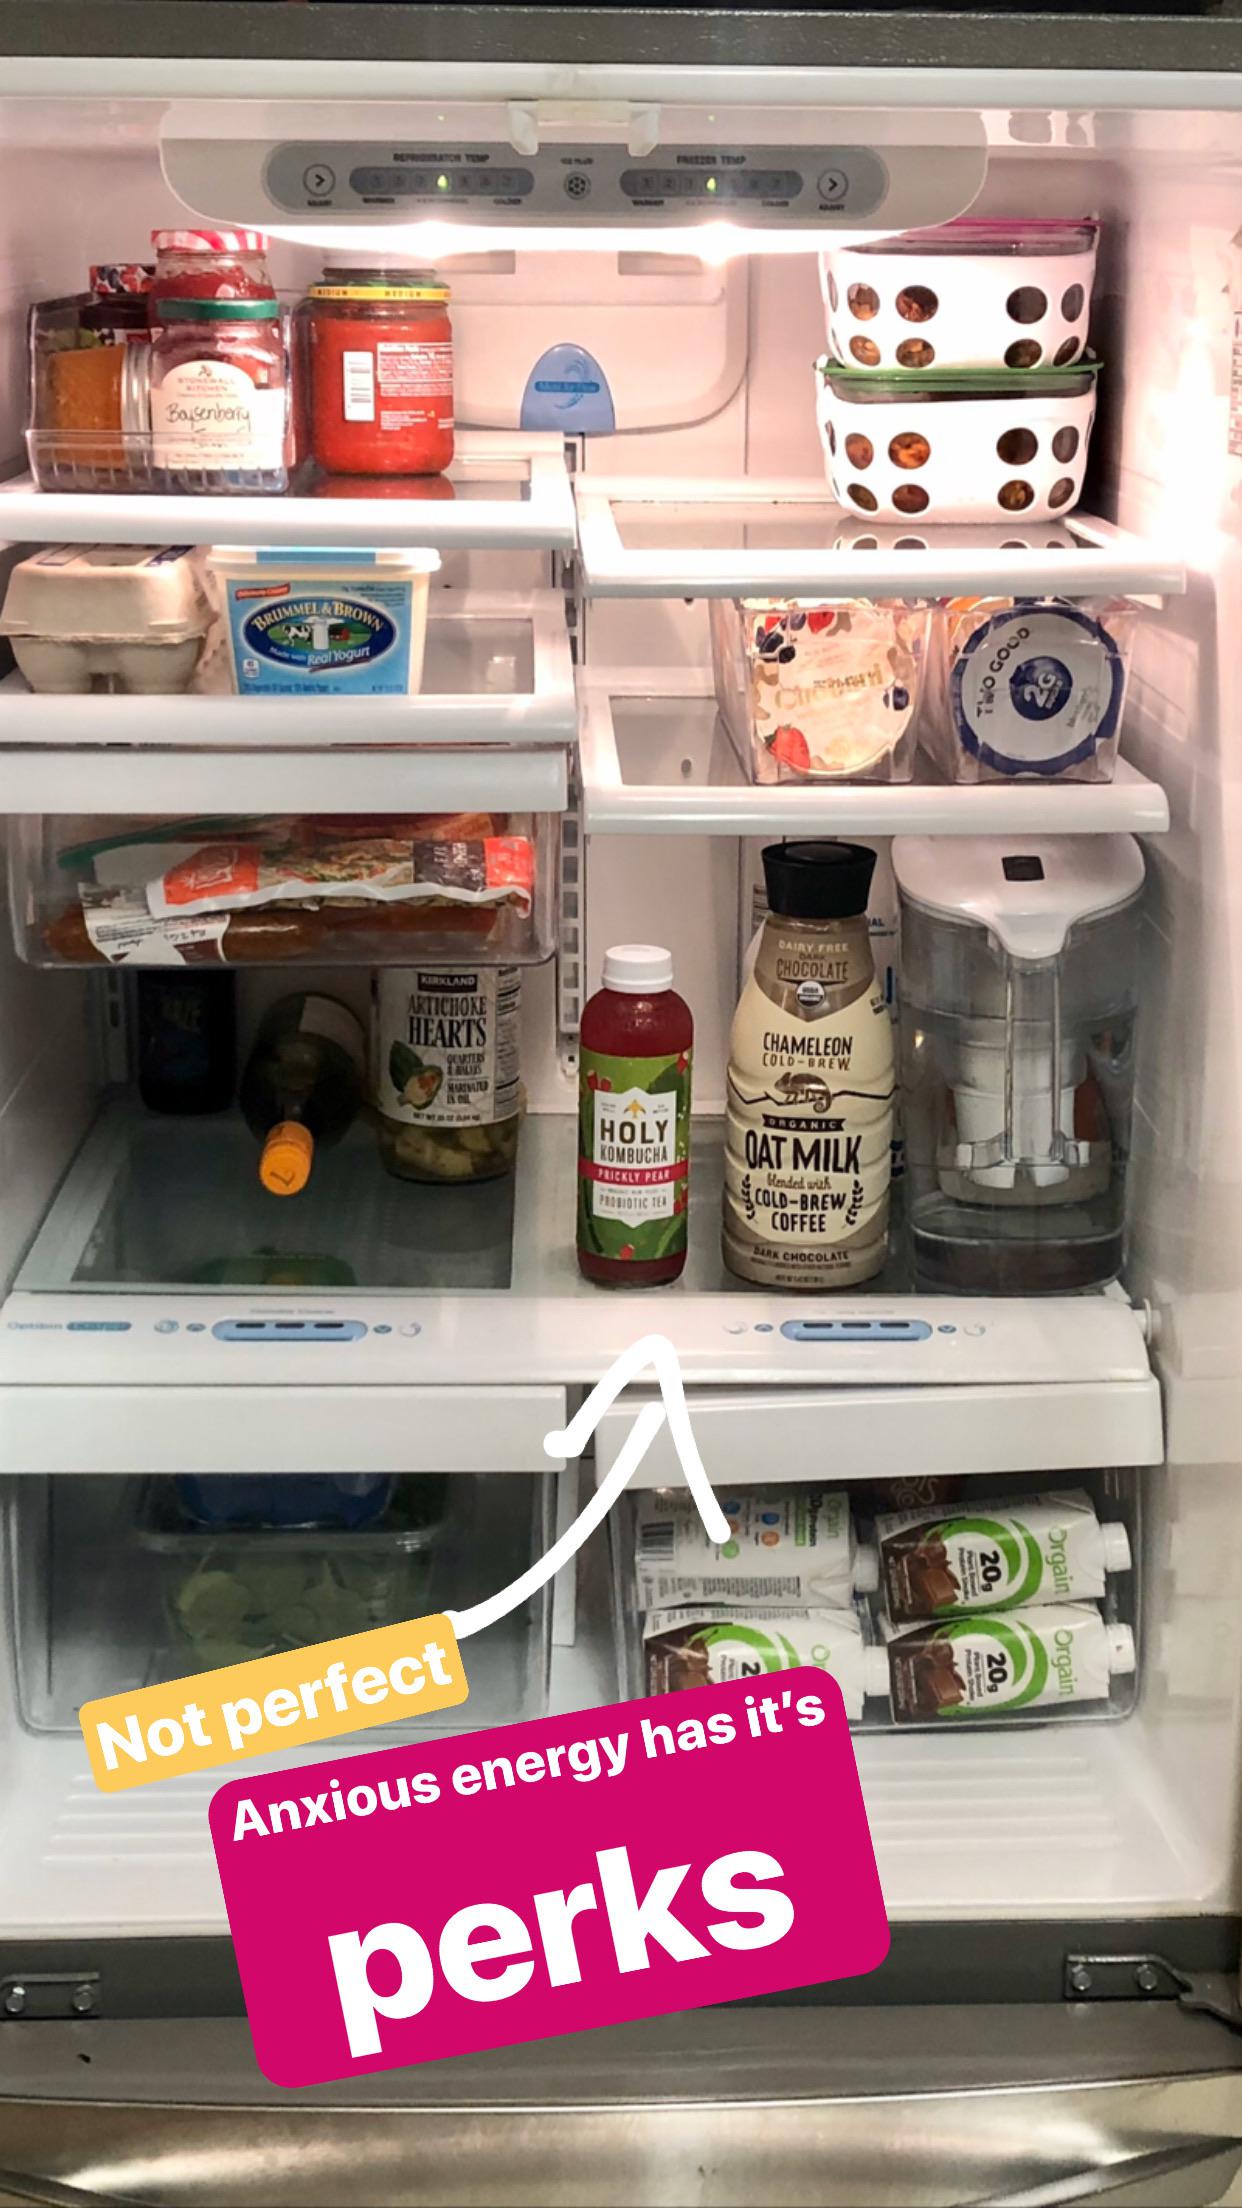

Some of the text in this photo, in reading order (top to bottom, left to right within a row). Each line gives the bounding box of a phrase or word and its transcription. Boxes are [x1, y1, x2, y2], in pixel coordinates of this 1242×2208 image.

[253, 603, 321, 632] BRUMMEL
[334, 601, 384, 632] BROWN
[307, 652, 332, 666] Real
[333, 646, 371, 664] Yogurt
[778, 938, 849, 953] DAIRY FREE
[420, 976, 476, 985] KIRKLAND
[775, 958, 849, 981] CHOCOLATE
[408, 993, 487, 1017] ARTICHOKE
[407, 1016, 487, 1049] HEARTS
[763, 1031, 853, 1056] CHAMELEON
[762, 1054, 851, 1071] COLD-BREW
[600, 1118, 669, 1145] HOLY
[768, 1117, 837, 1130] ORGANIC
[600, 1145, 668, 1165] KOMBUCHA
[745, 1129, 862, 1174] OAT MILK
[598, 1167, 671, 1184] PRICKLY PEAR
[766, 1172, 832, 1190] blended with
[599, 1194, 667, 1210] PROBIOTIC TEA
[755, 1188, 847, 1211] COLD-BREW
[771, 1211, 826, 1233] COFFEE
[753, 1246, 849, 1263] DARK CHOCOLATE
[979, 1550, 1002, 1592] 20g
[1045, 1527, 1073, 1596] Orgain
[986, 1651, 1009, 1694] 20g
[1050, 1628, 1078, 1697] Orgain
